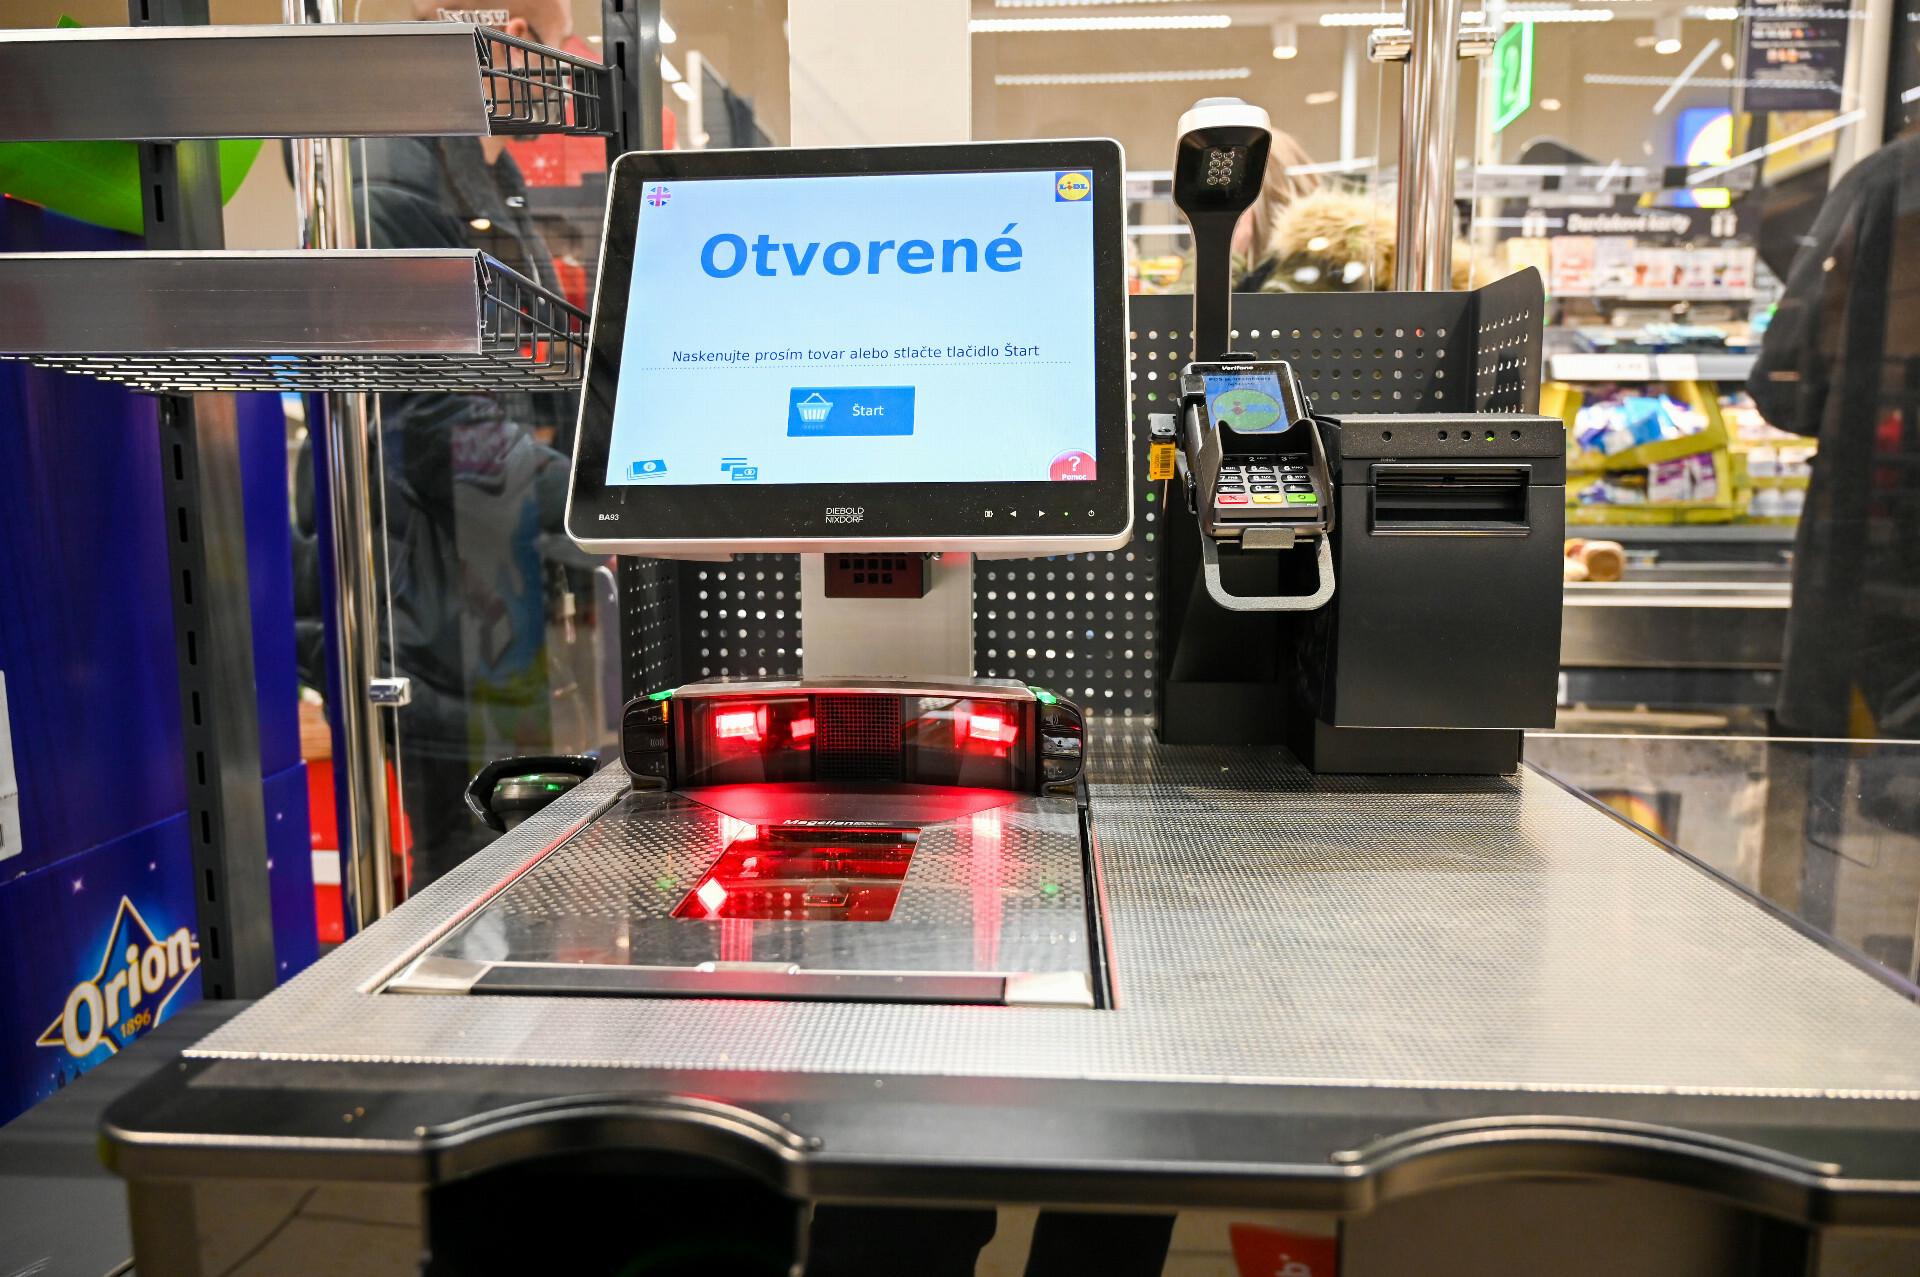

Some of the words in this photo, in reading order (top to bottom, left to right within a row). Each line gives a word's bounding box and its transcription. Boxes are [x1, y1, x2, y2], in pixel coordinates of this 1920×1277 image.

[701, 223, 1023, 278] Otvorené
[672, 350, 750, 364] Naskenujte
[755, 348, 803, 364] prosím
[808, 349, 846, 361] tovar
[850, 347, 889, 360] alebo
[893, 346, 942, 359] stlačte
[947, 345, 1000, 358] tlačidlo
[1004, 342, 1040, 357] Štart
[852, 403, 885, 417] Štart
[598, 513, 620, 521] BA93
[826, 507, 865, 515] DIEBOLD
[62, 926, 194, 1058] Orion
[120, 1009, 152, 1038] 1896
